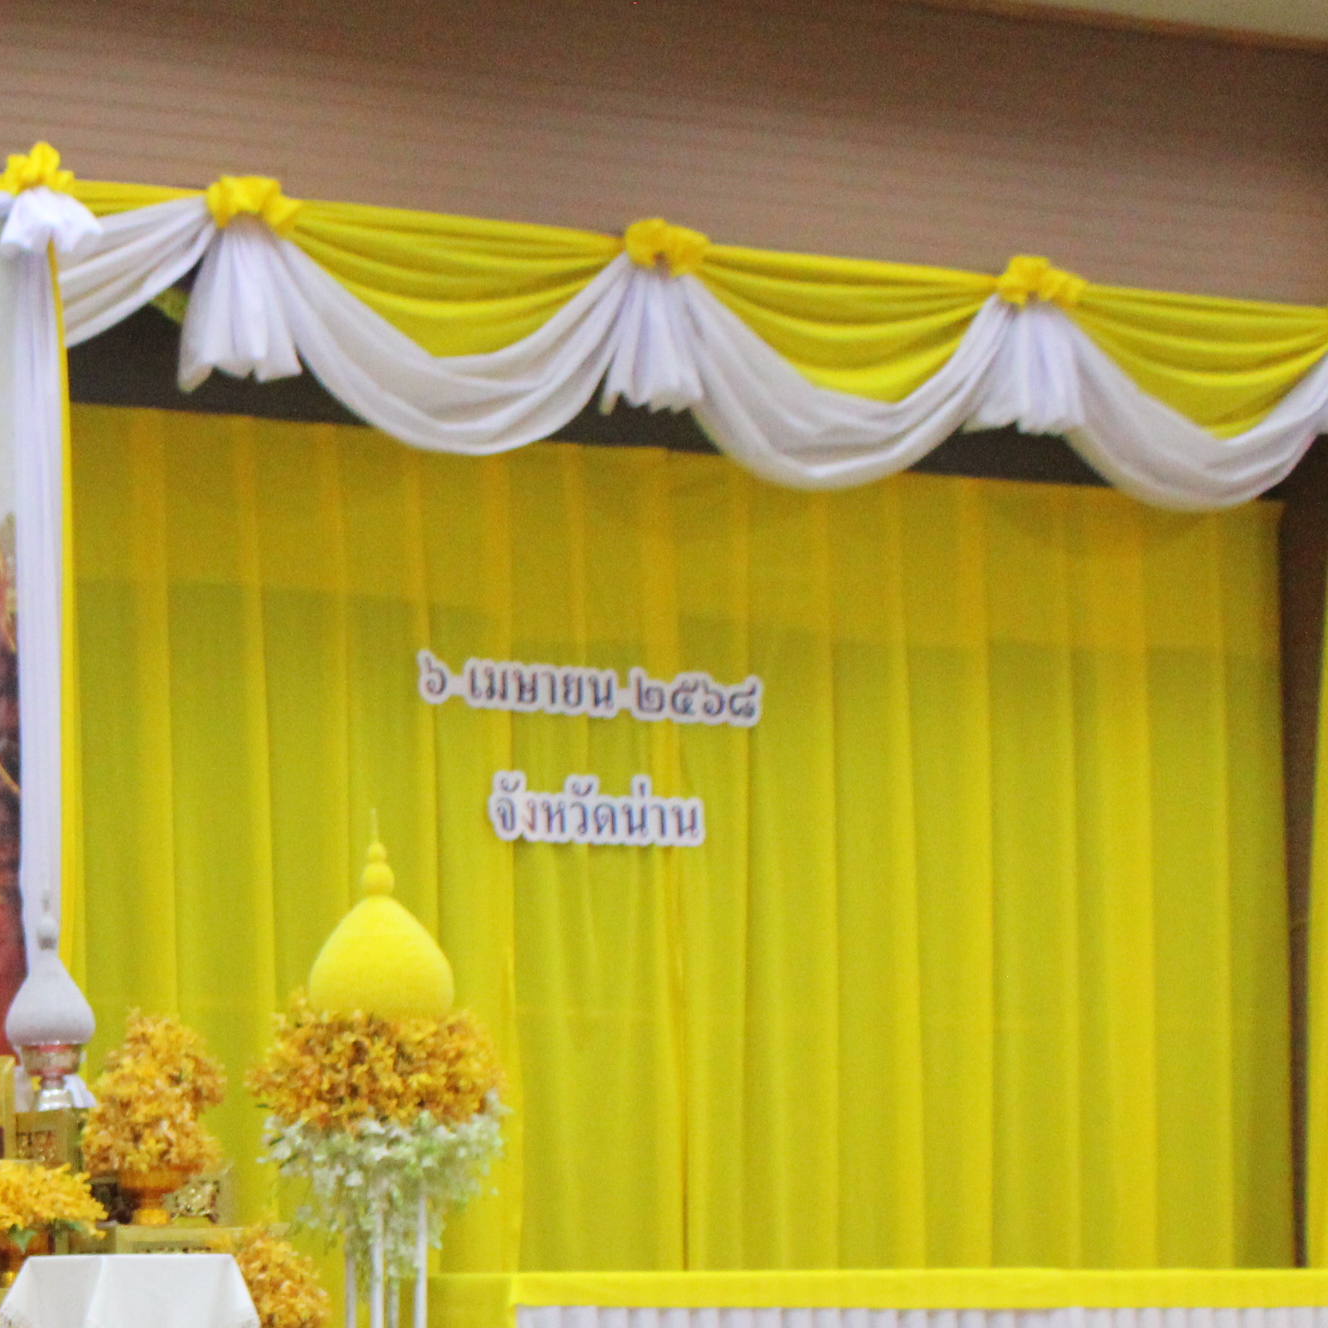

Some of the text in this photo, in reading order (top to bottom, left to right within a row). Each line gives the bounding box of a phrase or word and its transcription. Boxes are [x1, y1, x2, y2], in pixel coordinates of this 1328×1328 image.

[469, 666, 614, 709] เมษายน
[636, 675, 757, 719] ๒๕๖๘
[496, 776, 699, 838] จังหวัดน่าน
